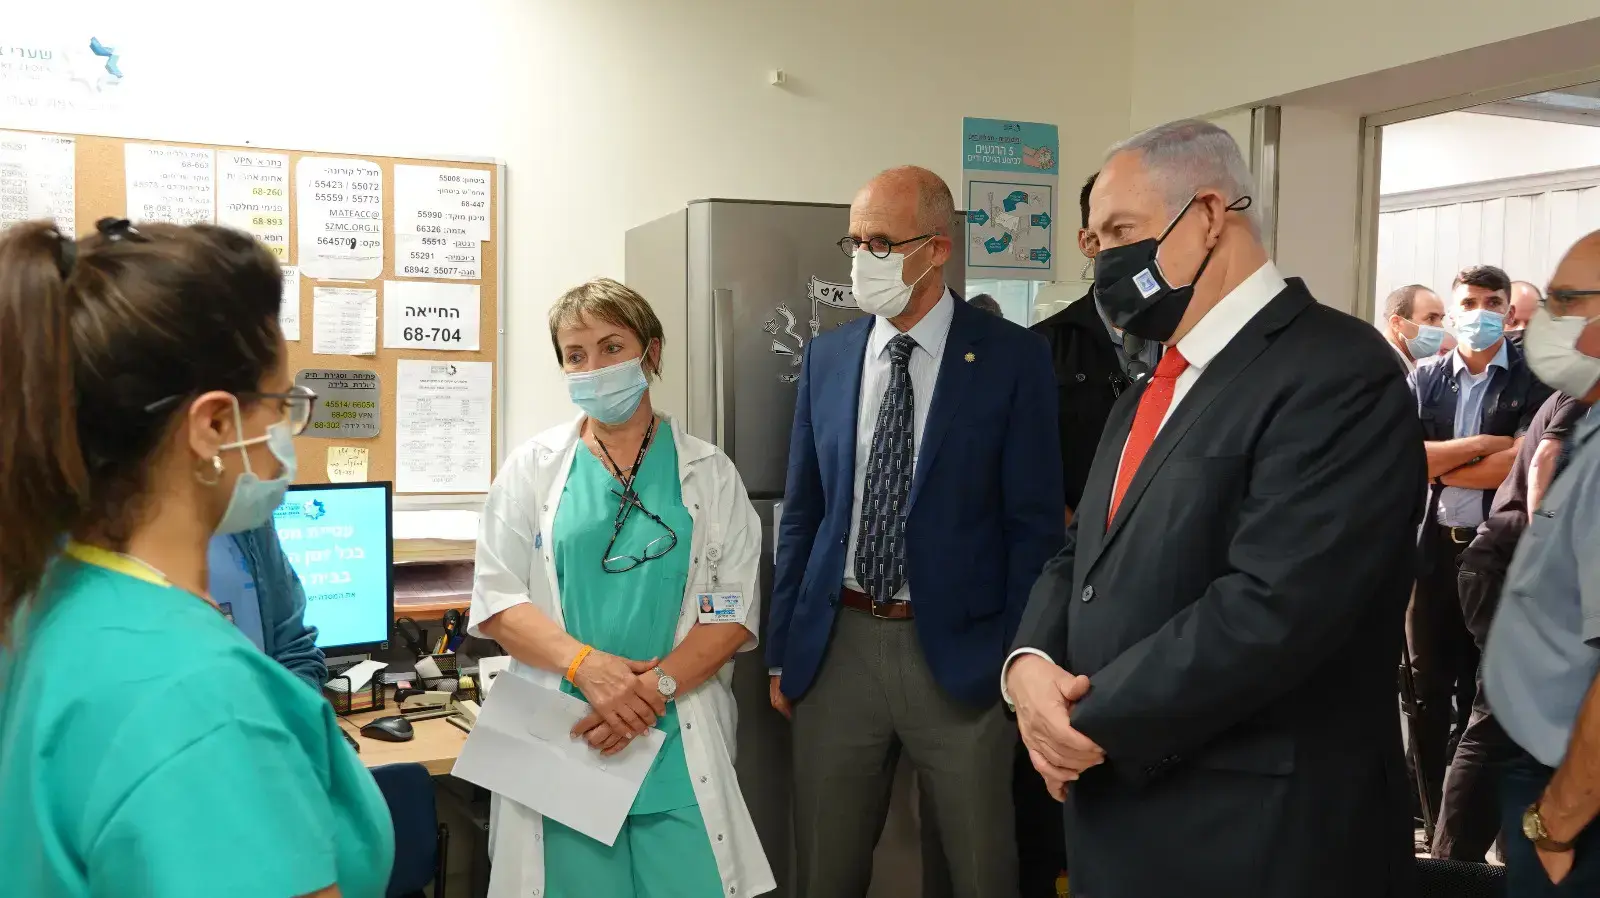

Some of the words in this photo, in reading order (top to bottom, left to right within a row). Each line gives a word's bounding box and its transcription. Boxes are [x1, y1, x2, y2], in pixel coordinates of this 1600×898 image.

[10, 47, 52, 59] שערי
[975, 144, 1006, 156] הרגעים
[1007, 146, 1014, 156] 5
[233, 156, 252, 165] VPN
[439, 174, 461, 182] 55008
[314, 180, 343, 189] 55423
[352, 182, 380, 191] 55072
[252, 187, 283, 196] 68-260
[315, 193, 343, 202] 55559
[352, 194, 380, 204] 55773
[262, 204, 283, 212] פנימי
[461, 200, 485, 208] 68-447
[417, 210, 442, 219] 55990
[252, 217, 283, 226] 68-893
[325, 222, 380, 233] SZMC.ORG.IL
[416, 225, 441, 234] 66326
[264, 233, 283, 242] רופא
[421, 237, 446, 246] 55513
[317, 237, 357, 250] 5645709
[360, 240, 381, 249] פקס:
[410, 251, 434, 260] 55291
[403, 265, 430, 274] 68942
[405, 304, 461, 319] החייאה
[402, 326, 462, 343] 68-704
[305, 371, 318, 381] תיק
[323, 372, 348, 380] וסגירת
[352, 373, 376, 381] פתיחה
[327, 381, 349, 389] בלידה
[358, 412, 373, 420] VPN
[314, 420, 341, 430] 68-302
[334, 545, 365, 559] בכל
[305, 549, 332, 569] זמן
[309, 571, 352, 585] בבית
